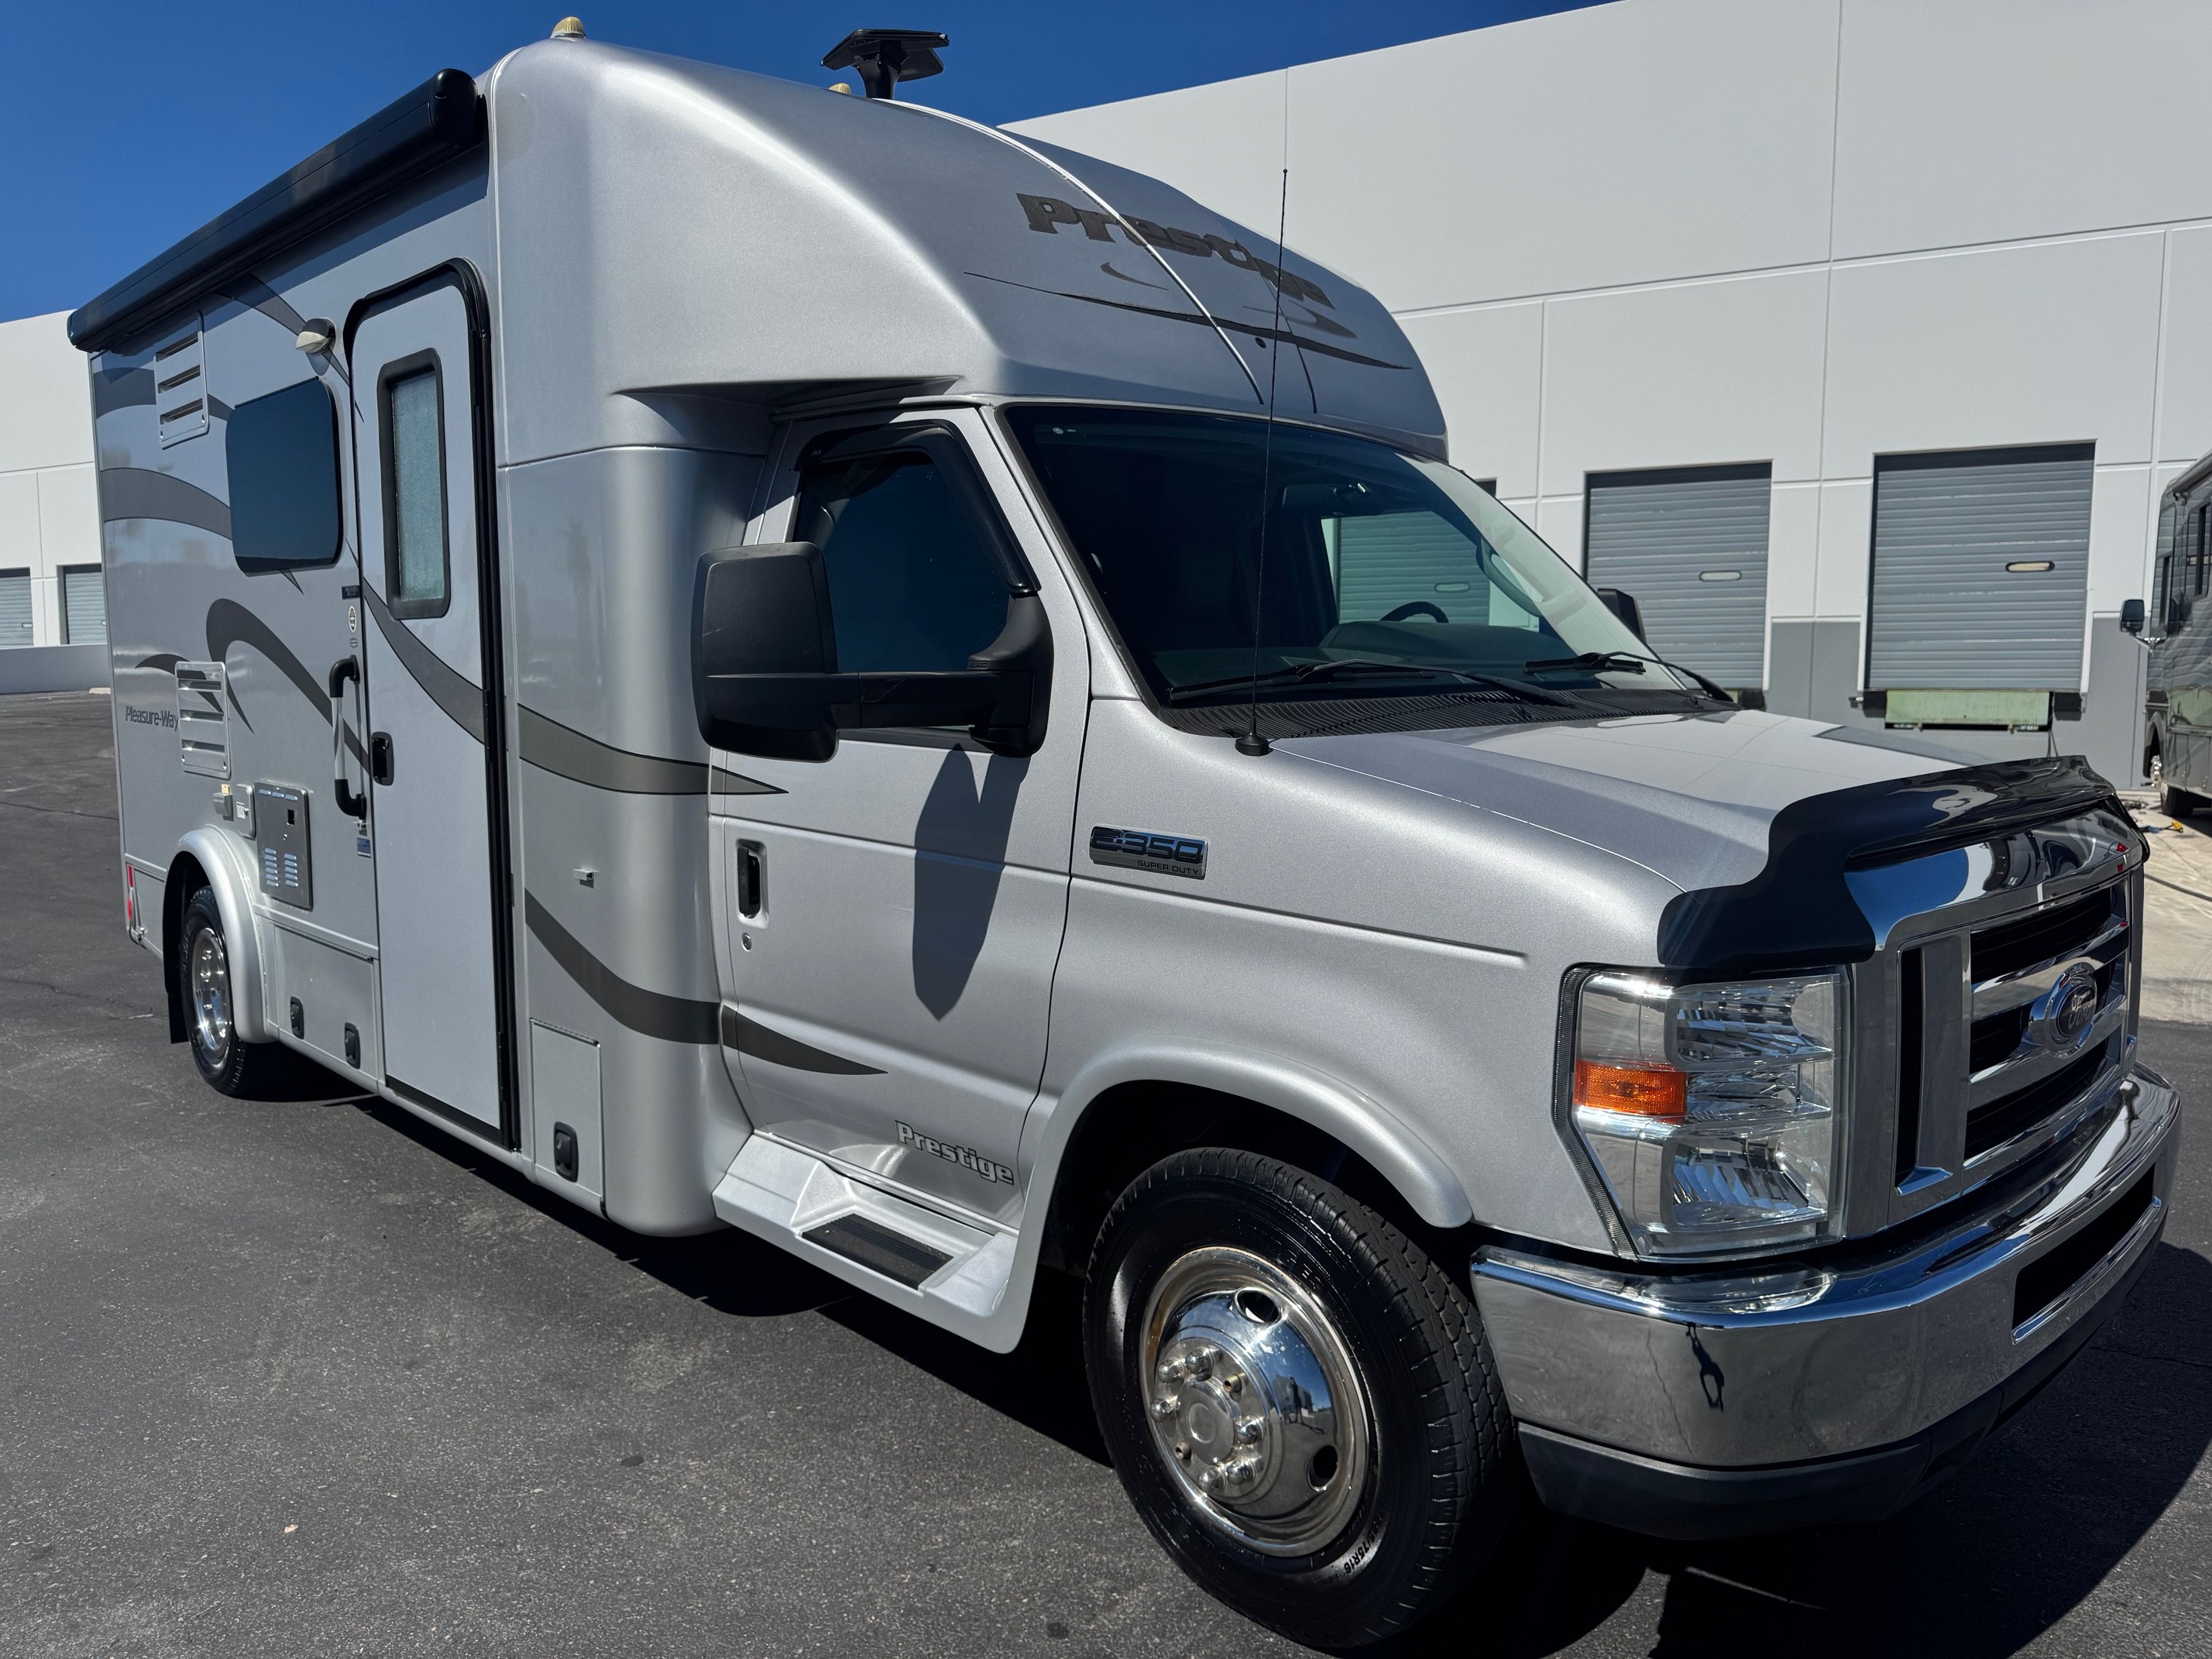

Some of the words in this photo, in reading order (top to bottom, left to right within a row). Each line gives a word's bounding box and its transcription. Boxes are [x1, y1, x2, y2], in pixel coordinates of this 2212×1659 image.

[125, 706, 179, 732] Pleasure-Way
[1137, 860, 1170, 871] SUPER
[1172, 865, 1199, 875] DUTY
[895, 1120, 1015, 1186] Prestige
